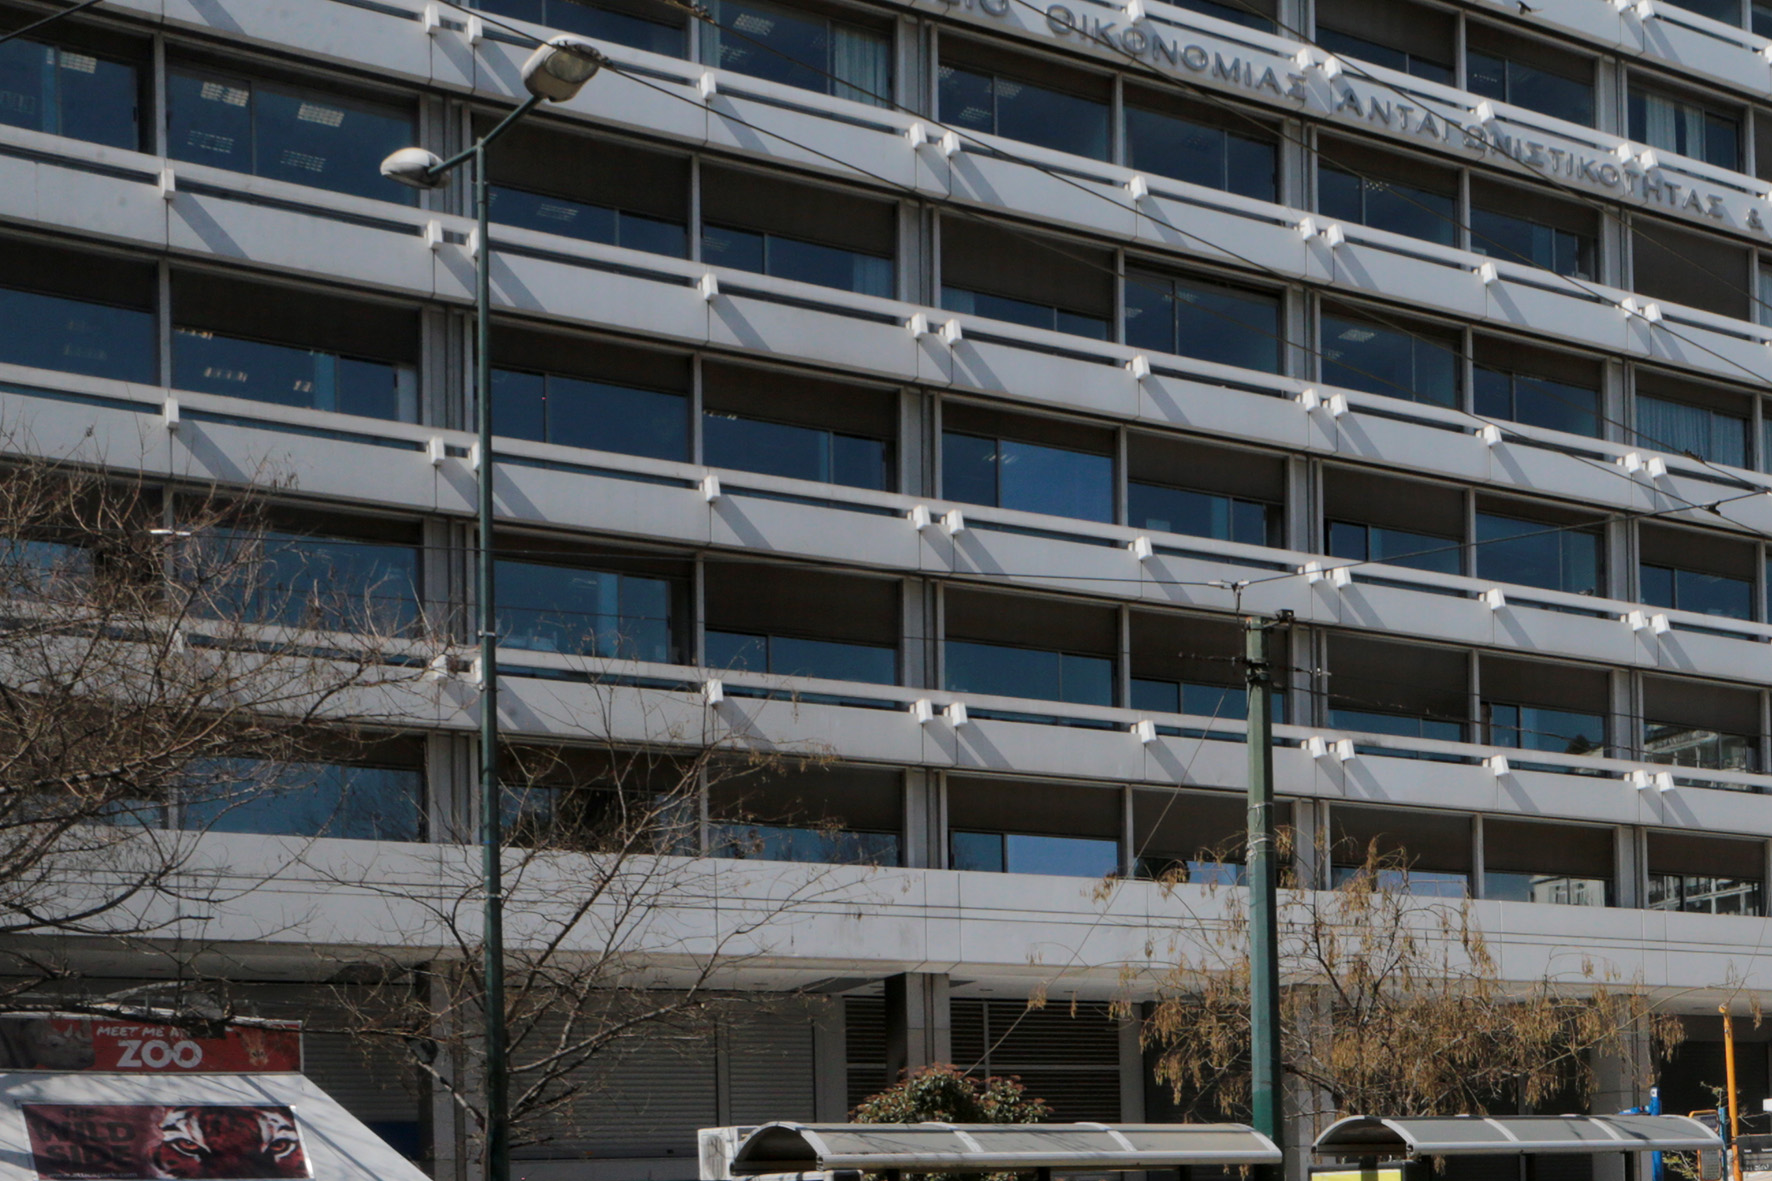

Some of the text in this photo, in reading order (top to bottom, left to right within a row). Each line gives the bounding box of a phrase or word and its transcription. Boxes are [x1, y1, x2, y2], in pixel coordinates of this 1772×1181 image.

[1046, 4, 1306, 101] ΟΙΚΟΝΟΜΙΑΣ
[1336, 86, 1724, 218] ΑΝΤΑΓΩΝΙΣΤΙΚΟΤΗΤΑΣ
[97, 1026, 139, 1037] MEET
[142, 1027, 164, 1037] ME
[116, 1040, 203, 1068] ZOO
